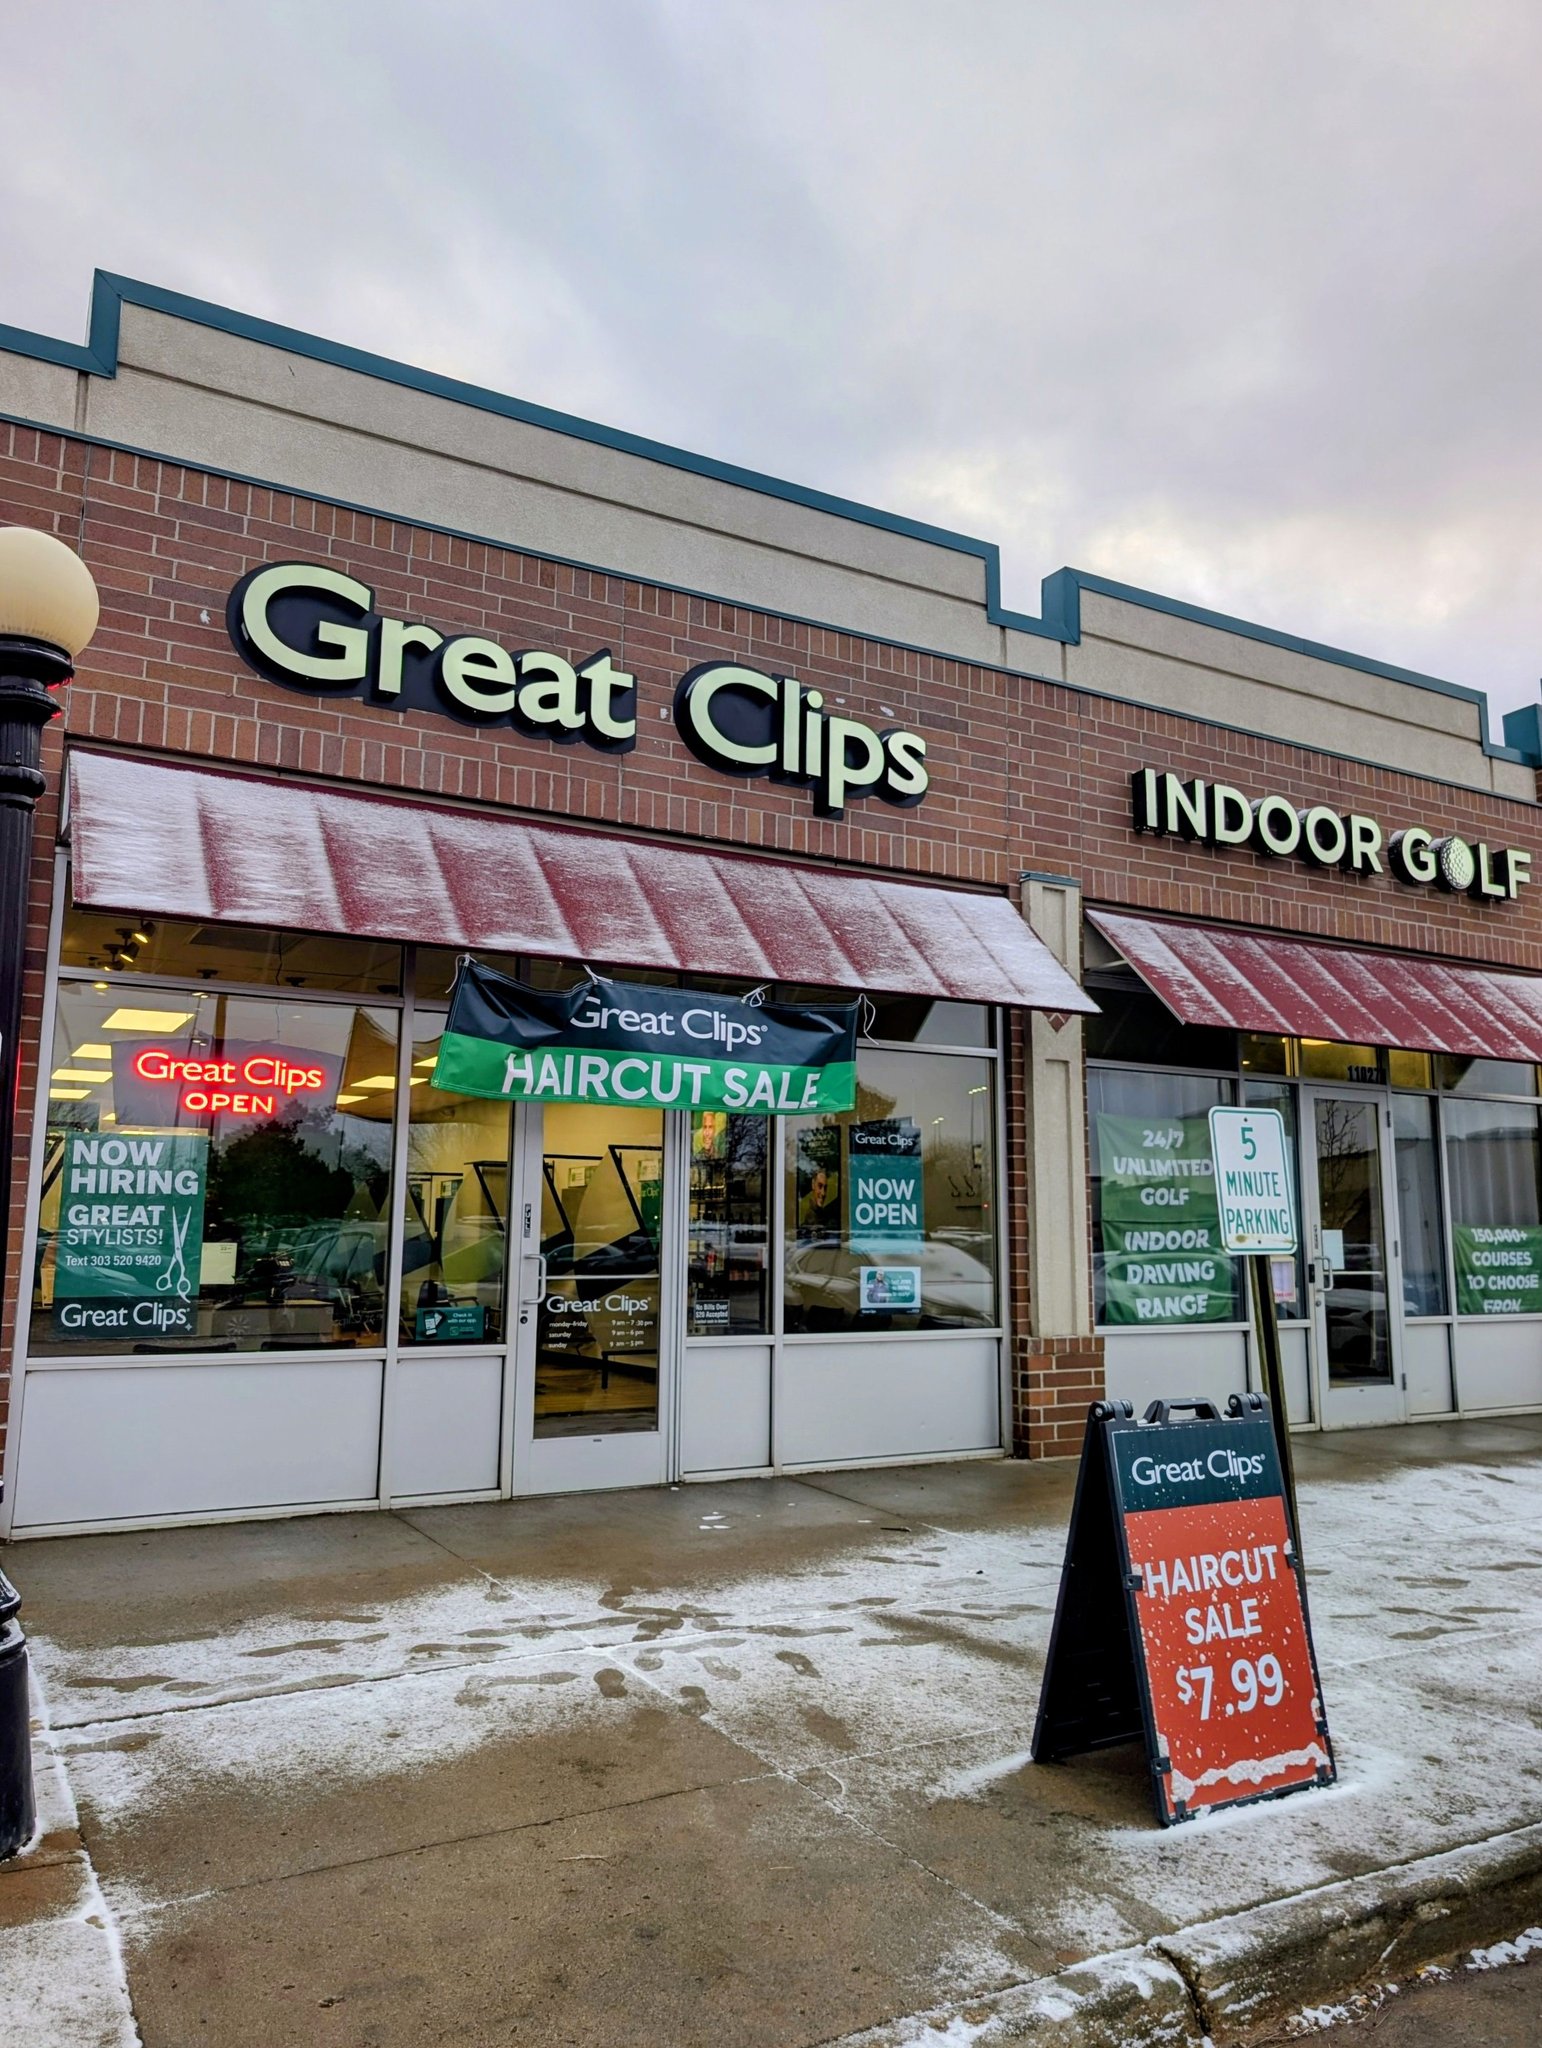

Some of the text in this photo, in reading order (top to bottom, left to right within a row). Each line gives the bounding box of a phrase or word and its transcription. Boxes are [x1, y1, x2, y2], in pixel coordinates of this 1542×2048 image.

[242, 564, 930, 809] Great Clips
[1144, 767, 1532, 899] INDOOR GOLF
[570, 997, 675, 1037] Great
[137, 1052, 322, 1094] Great Clips
[501, 1052, 822, 1109] HAIRCUT SALE
[185, 1092, 273, 1114] OPEN
[855, 1133, 886, 1145] Great
[1142, 1128, 1184, 1149] 24/7
[1240, 1126, 1256, 1160] 5
[72, 1139, 164, 1166] NOW
[1113, 1156, 1214, 1176] UNLIMITED
[70, 1168, 199, 1196] HIRING
[858, 1178, 915, 1200] NOW
[1226, 1170, 1281, 1197] MINUTE
[1140, 1187, 1189, 1205] GOLF
[68, 1204, 165, 1226] GREAT
[855, 1202, 917, 1225] OPEN
[1226, 1208, 1289, 1234] PARKING
[66, 1228, 164, 1246] STYLISTS!
[1125, 1229, 1210, 1251] INDOOR
[1471, 1228, 1527, 1245] 150,000+
[65, 1255, 162, 1266] Text 303 520 9420
[1471, 1251, 1533, 1267] COURSES
[1126, 1260, 1215, 1285] DRIVING
[1466, 1274, 1539, 1290] TO CHOOSE
[61, 1302, 187, 1332] Great Clips
[546, 1294, 649, 1316] Great Clips
[1136, 1294, 1209, 1319] RANGE
[1131, 1449, 1264, 1486] Great Clips
[1145, 1545, 1277, 1599] HAIRCUT
[1184, 1598, 1262, 1645] SALE
[1176, 1653, 1284, 1721] $7.99
